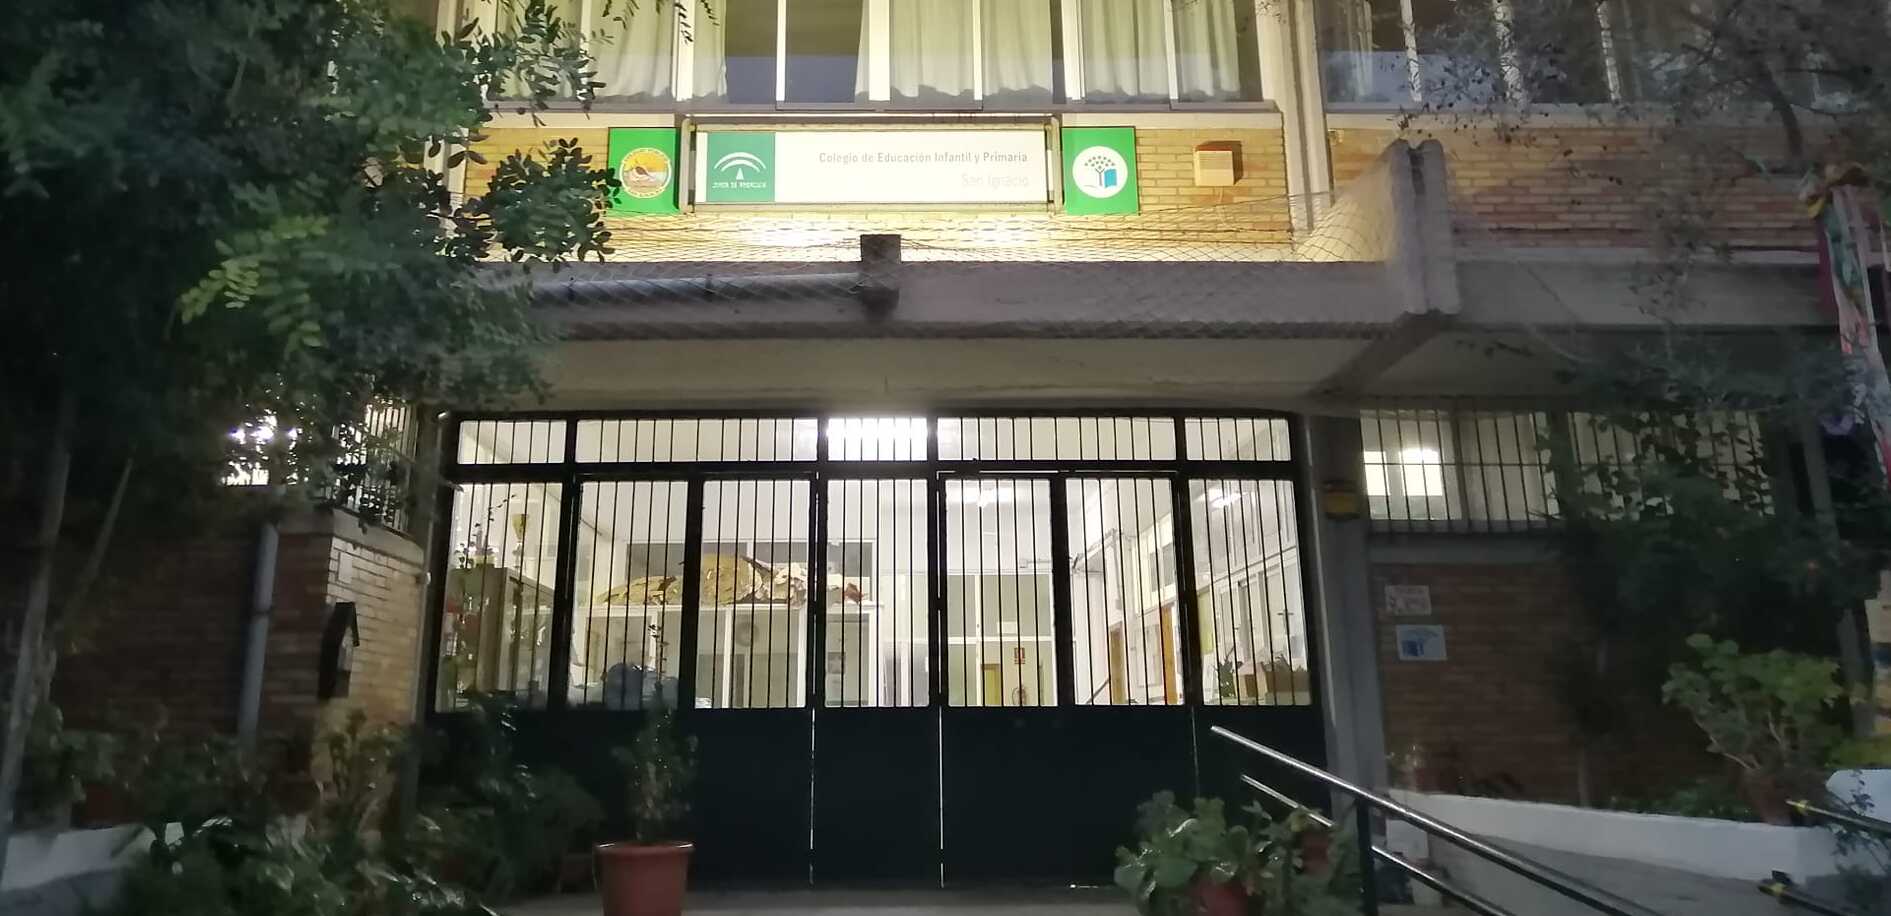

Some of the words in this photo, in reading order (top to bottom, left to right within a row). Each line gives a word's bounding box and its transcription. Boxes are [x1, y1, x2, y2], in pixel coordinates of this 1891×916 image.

[819, 151, 859, 165] Colegio
[861, 151, 874, 163] de
[877, 151, 931, 163] Educación
[934, 151, 972, 163] Infantil
[973, 154, 981, 165] y
[983, 151, 1028, 163] Primaria
[961, 173, 983, 186] San
